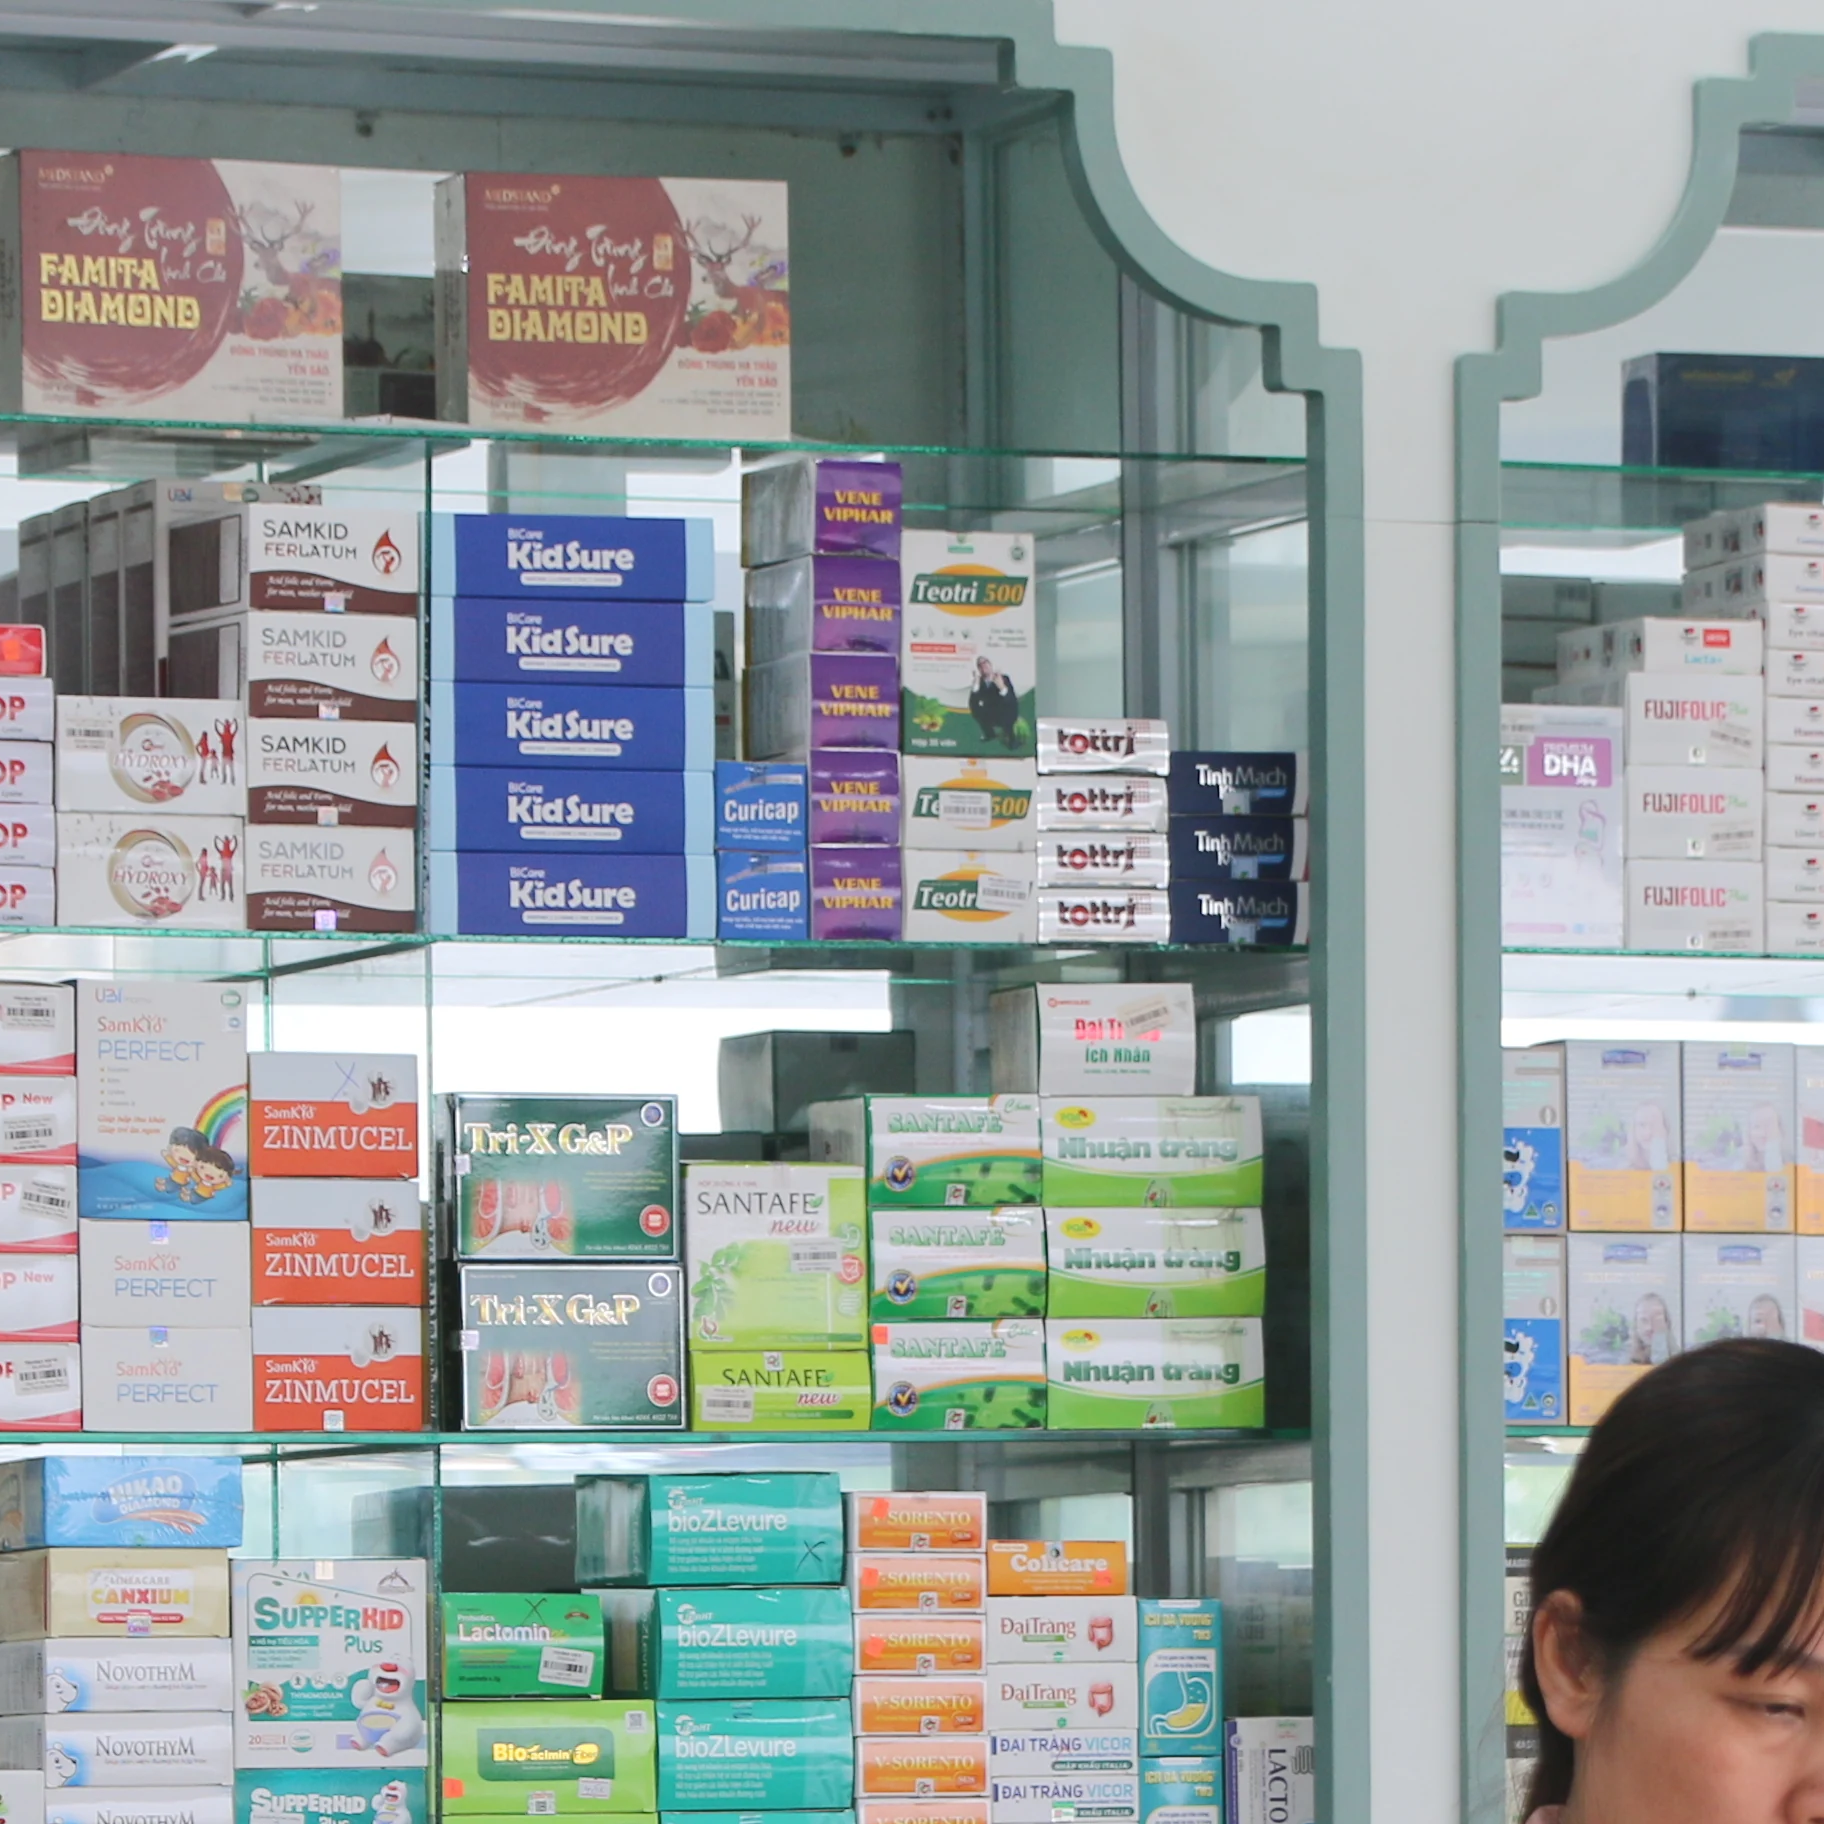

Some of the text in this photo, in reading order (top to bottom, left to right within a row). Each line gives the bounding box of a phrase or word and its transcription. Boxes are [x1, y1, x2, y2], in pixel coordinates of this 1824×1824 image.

[41, 255, 160, 289] FAMITA
[41, 290, 199, 330] DIAMOND
[824, 508, 893, 525] VIPHAR
[263, 522, 348, 540] SAMKID
[264, 543, 358, 560] FERLATUM
[834, 587, 882, 603] VENE
[916, 580, 1024, 603] Teotri 500
[508, 626, 633, 656] KidSure
[1543, 756, 1597, 776] DHA
[114, 870, 188, 888] HYDROXY
[724, 888, 797, 912] Curicap
[22, 1093, 53, 1105] New
[467, 1122, 634, 1155] Tri-X G&P
[698, 1193, 819, 1215] SANTAFE
[770, 1218, 817, 1234] new
[266, 1253, 414, 1278] ZINMUCEL
[115, 1277, 217, 1299] PERFECT
[1063, 1359, 1240, 1385] Nhuận tràng
[669, 1511, 788, 1533] bioZLevure
[1012, 1553, 1106, 1573] Colicare
[92, 1587, 189, 1605] CANXIUM
[254, 1598, 404, 1632] SUPPERKID
[459, 1623, 551, 1642] Lactomin
[345, 1635, 383, 1654] Plus
[96, 1735, 195, 1757] NOVOTHYM
[1001, 1734, 1132, 1754] ĐẠI TRÀNG VICOR
[876, 1755, 974, 1770] V-SORENTO
